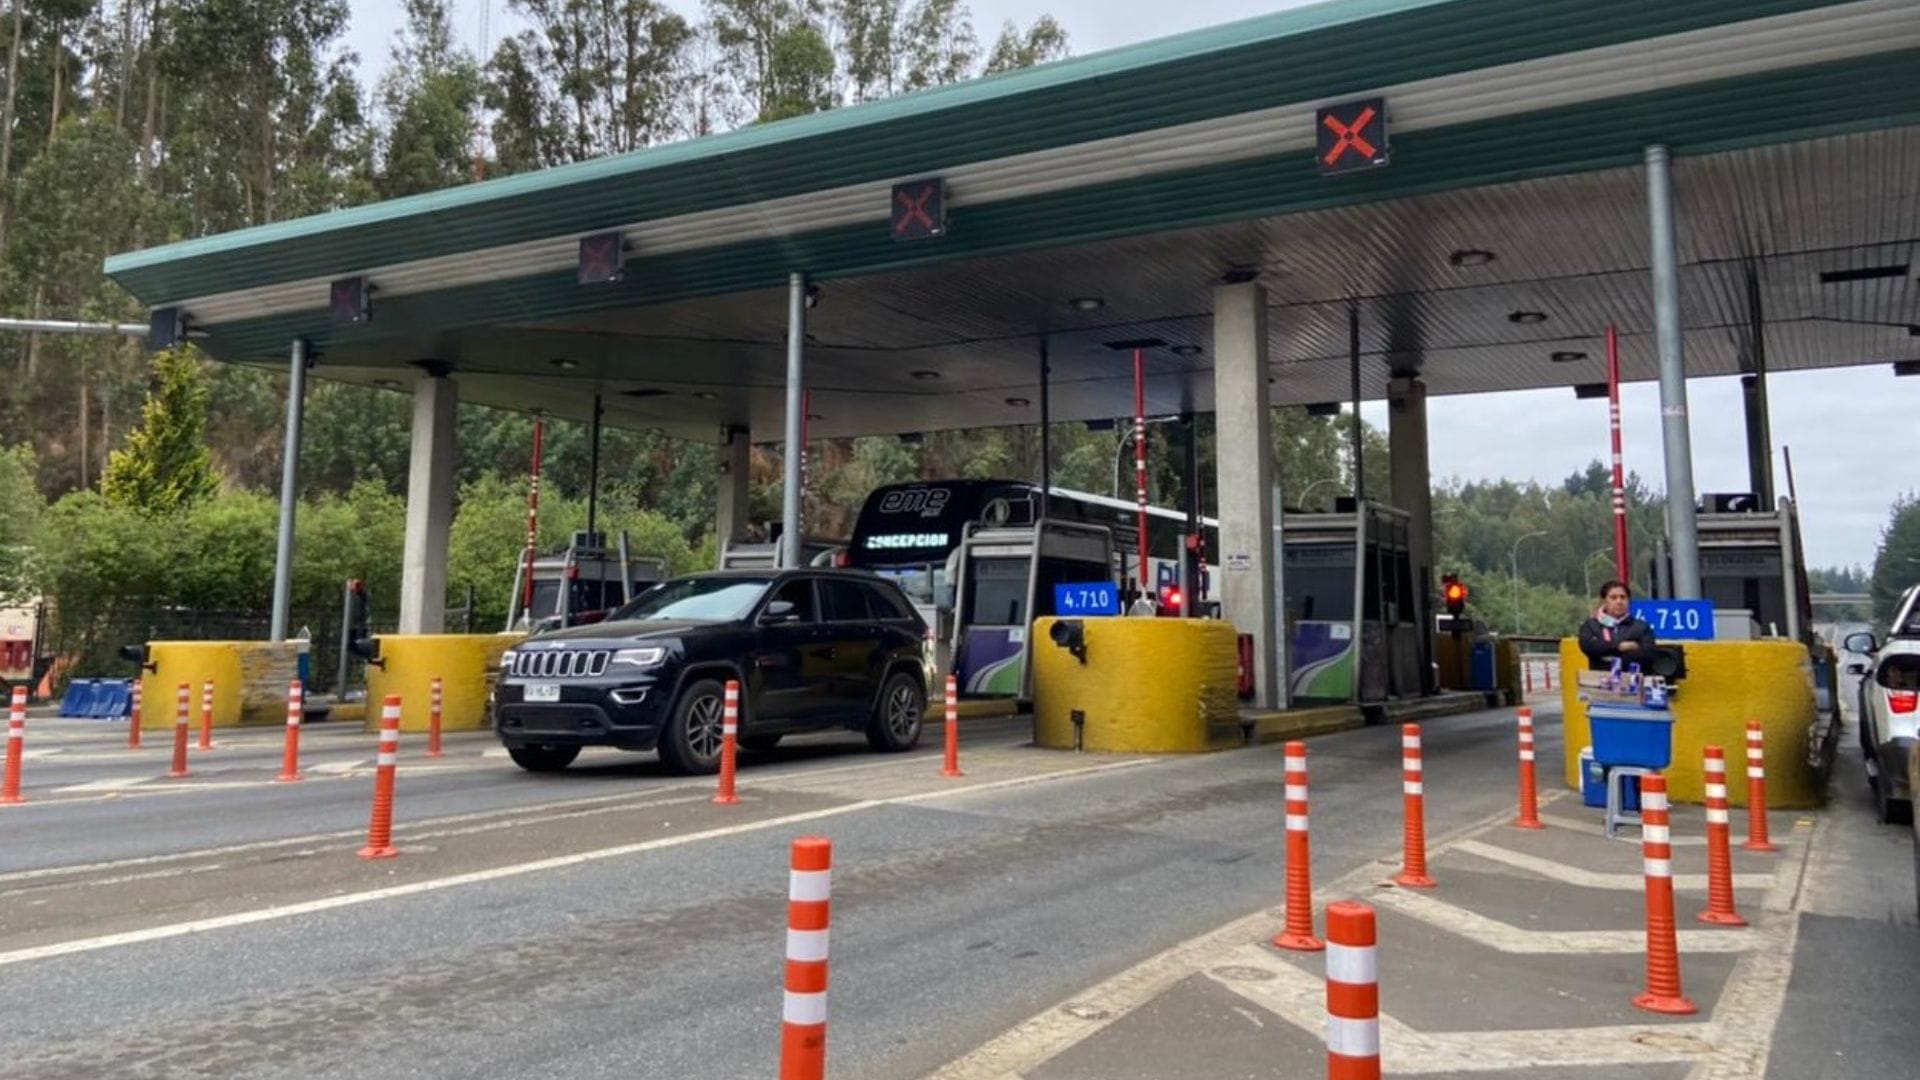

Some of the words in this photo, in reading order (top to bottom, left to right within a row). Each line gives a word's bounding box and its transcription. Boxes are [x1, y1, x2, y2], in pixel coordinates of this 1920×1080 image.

[879, 486, 950, 514] eme
[866, 533, 948, 549] CONCEPCION
[1064, 590, 1109, 608] 4.710
